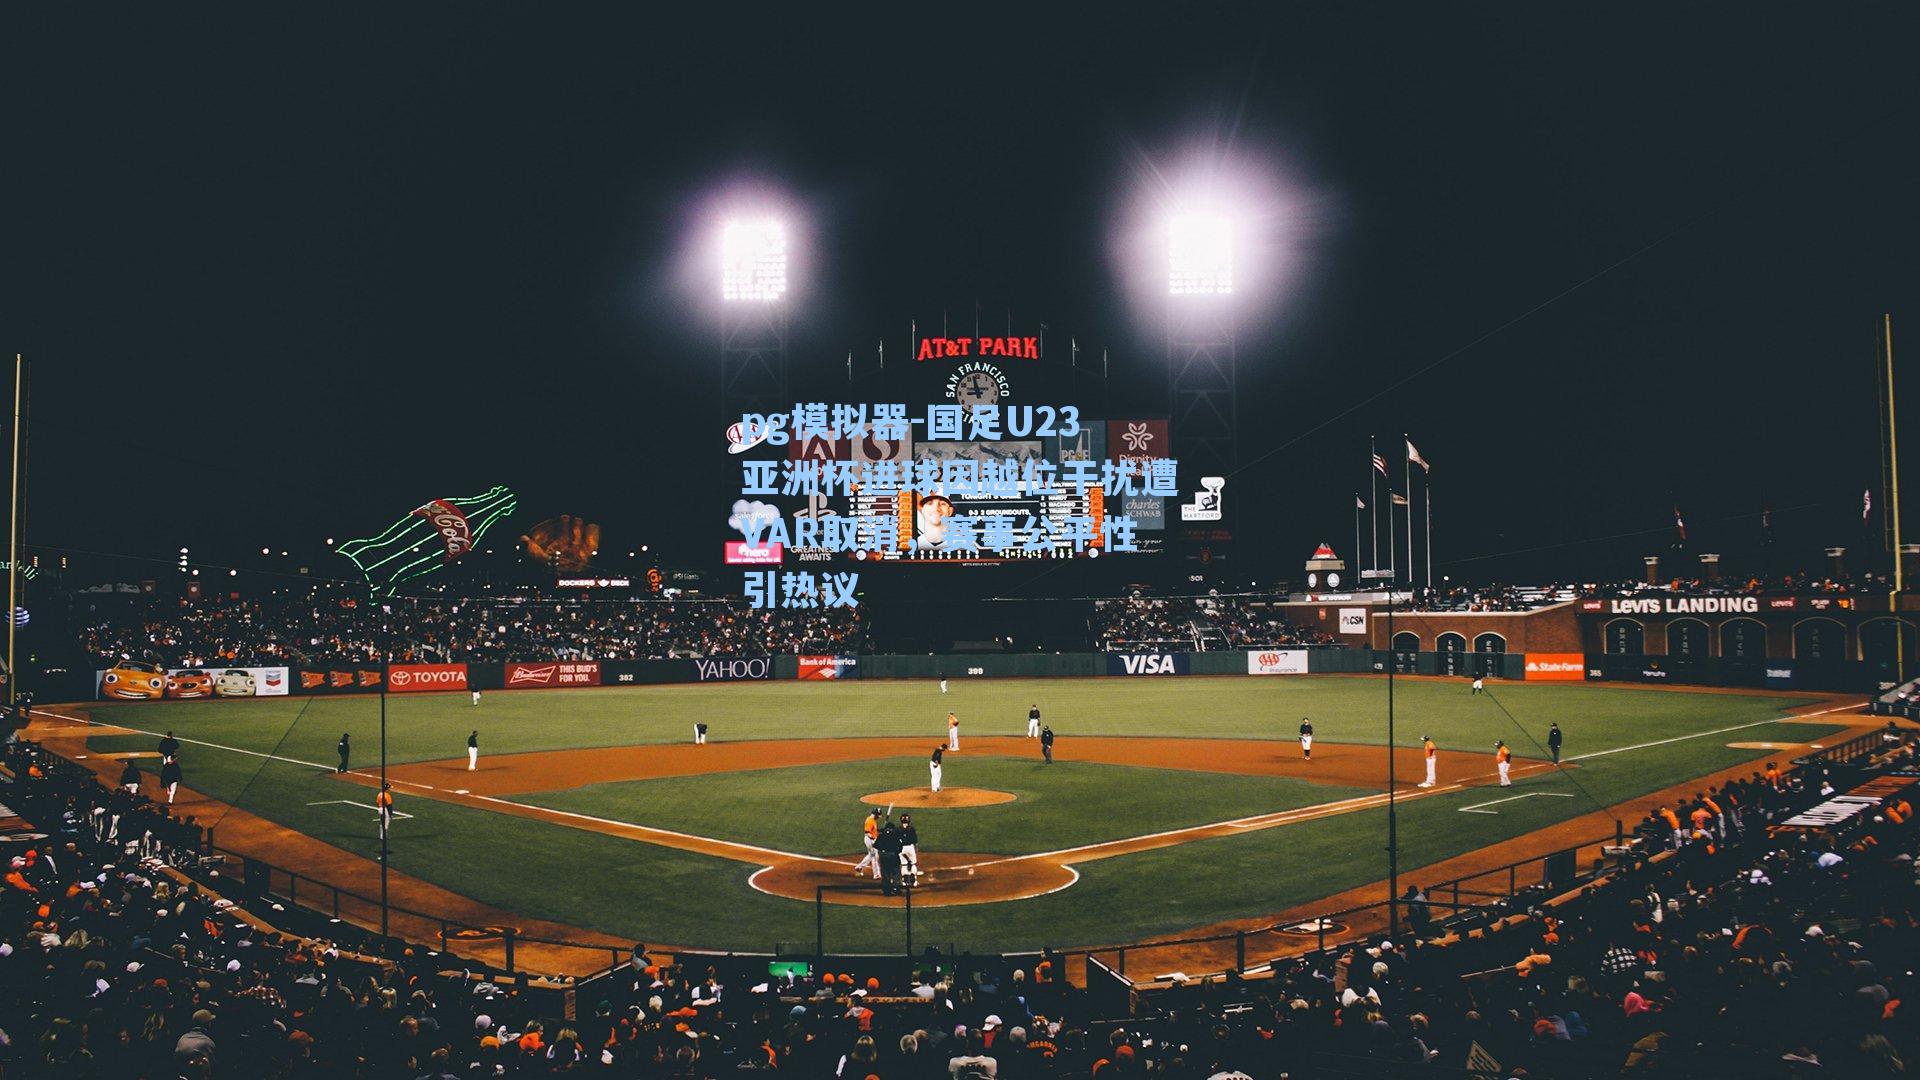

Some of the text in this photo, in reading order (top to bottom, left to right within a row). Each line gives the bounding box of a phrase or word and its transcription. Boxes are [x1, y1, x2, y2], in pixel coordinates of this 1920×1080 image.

[917, 336, 1038, 361] AT&T PARK
[946, 362, 1010, 398] SAN FRANCISCO
[1126, 499, 1160, 509] charles
[1665, 597, 1758, 613] LANDING
[1350, 616, 1364, 625] CSN
[800, 658, 856, 666] Bank of America
[1119, 655, 1176, 674] VISA
[515, 669, 550, 679] Budweiser
[559, 664, 598, 674] THIS BUD'S
[695, 659, 770, 681] YAHOO!
[413, 671, 467, 683] TOYOTA
[559, 674, 590, 682] FOR YOU.
